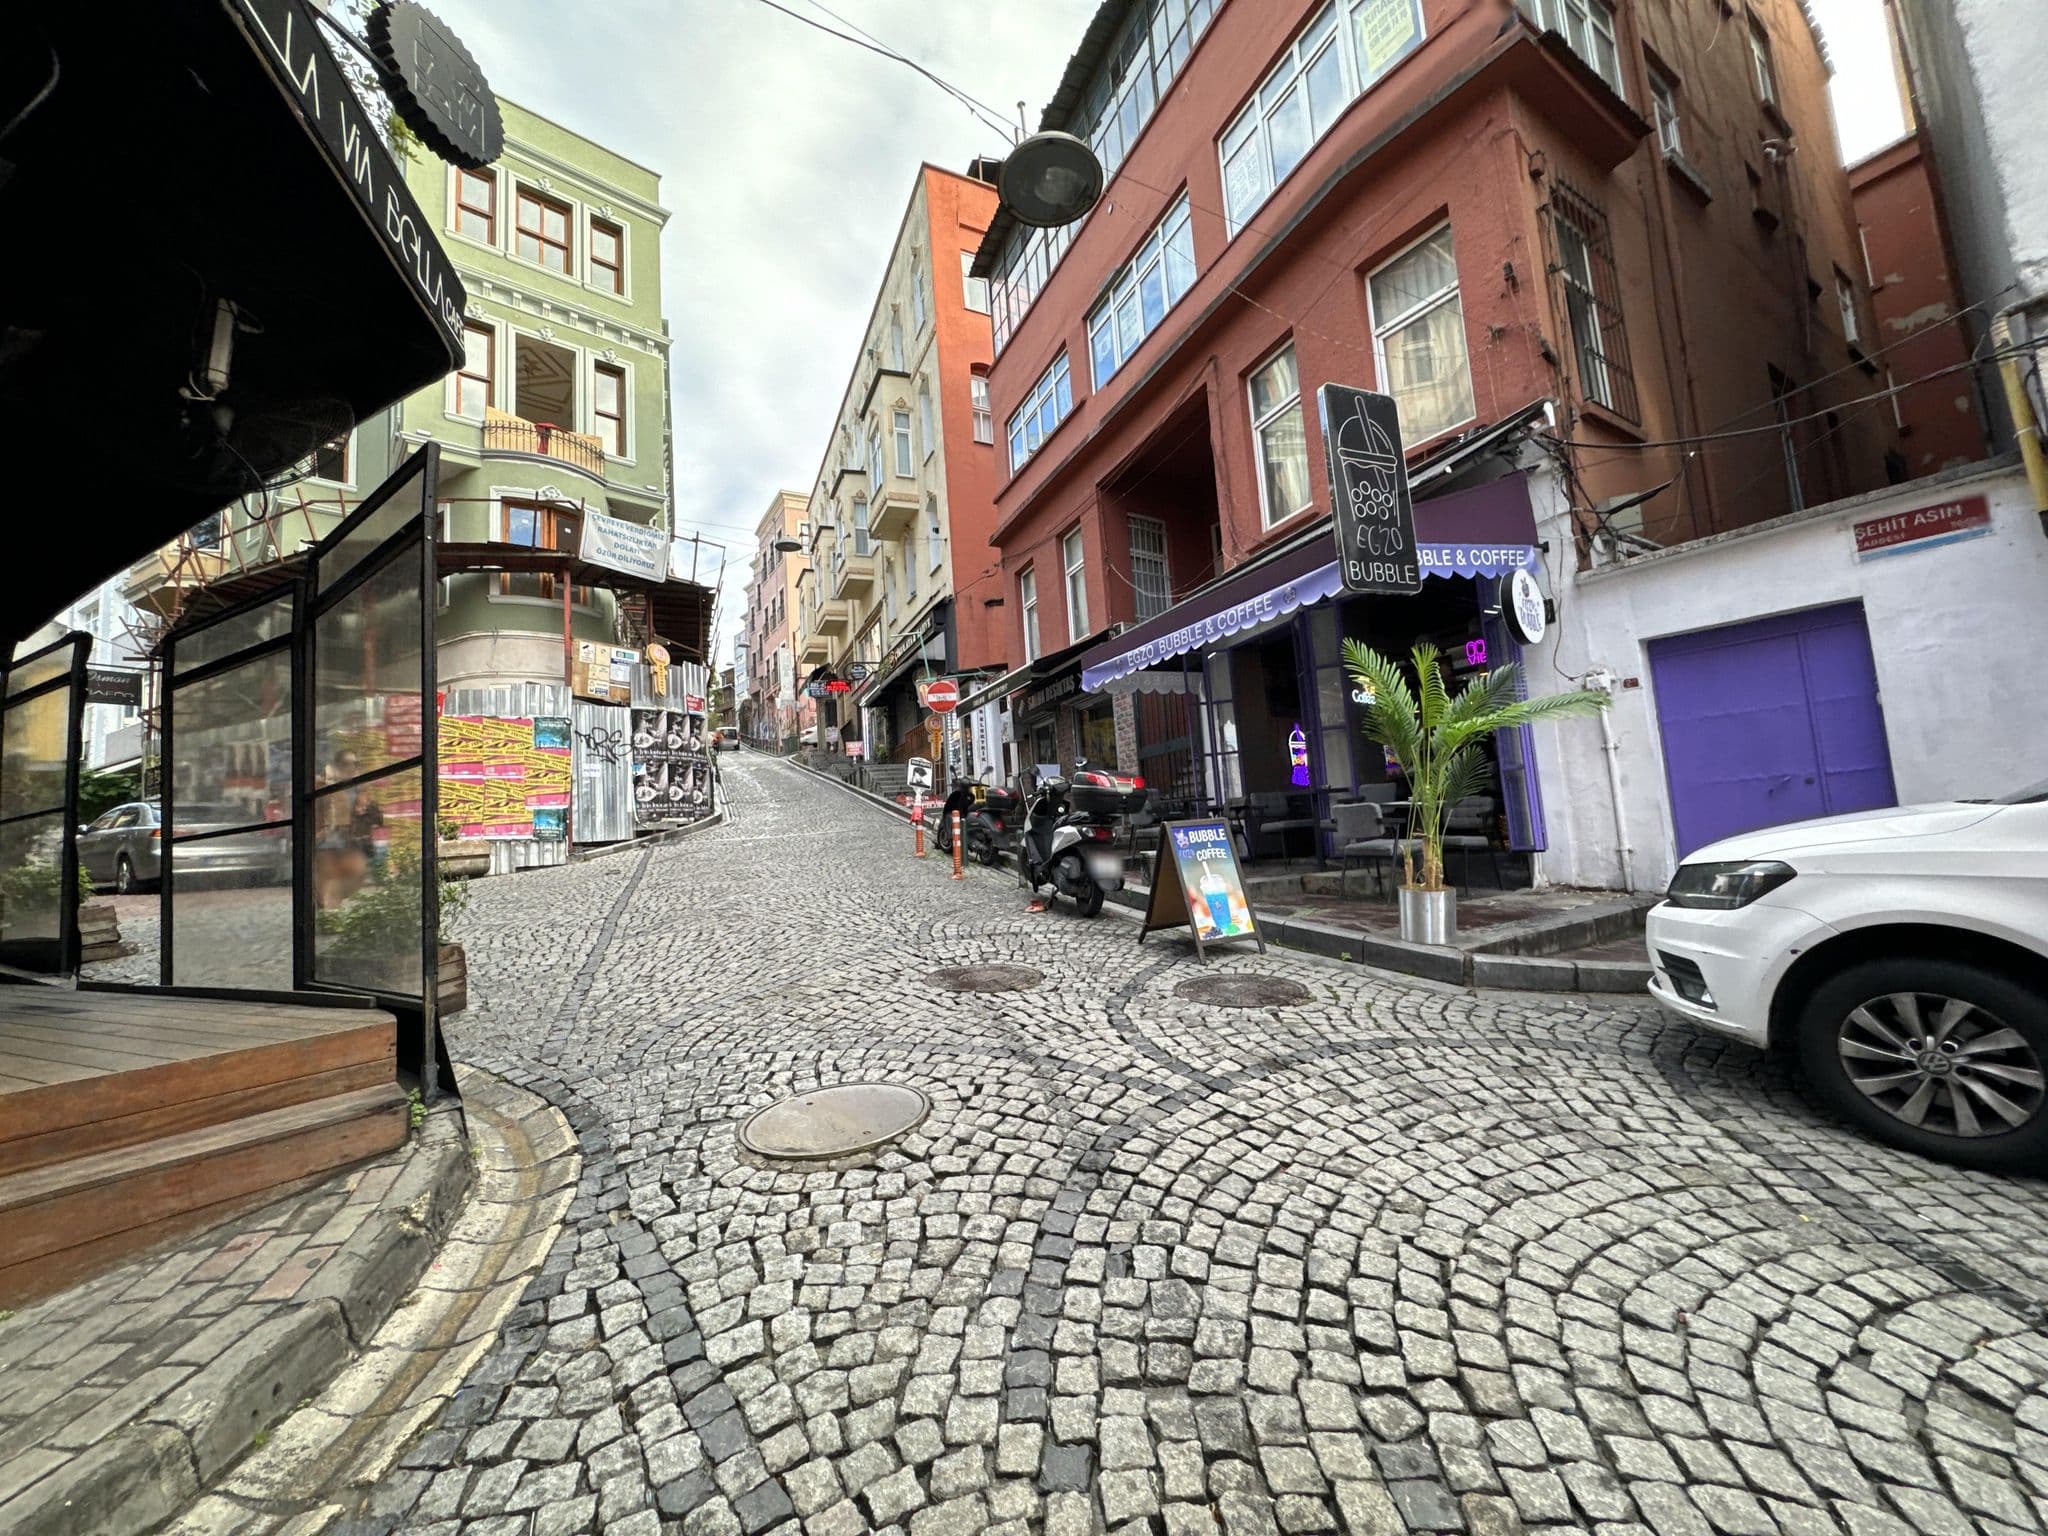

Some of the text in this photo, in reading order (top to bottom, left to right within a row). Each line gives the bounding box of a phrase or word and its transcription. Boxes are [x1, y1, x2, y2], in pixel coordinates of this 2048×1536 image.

[1855, 516, 1909, 540] ŞEHİT
[1913, 504, 1963, 527] ASIM
[1456, 549, 1467, 566] &
[1470, 549, 1528, 566] COFFEE
[1349, 560, 1417, 584] BUBBLE
[1127, 594, 1273, 667] EGZO BUBBLE & COFFEE
[1188, 828, 1227, 844] BUBBLE
[1196, 848, 1228, 862] COFFEE
